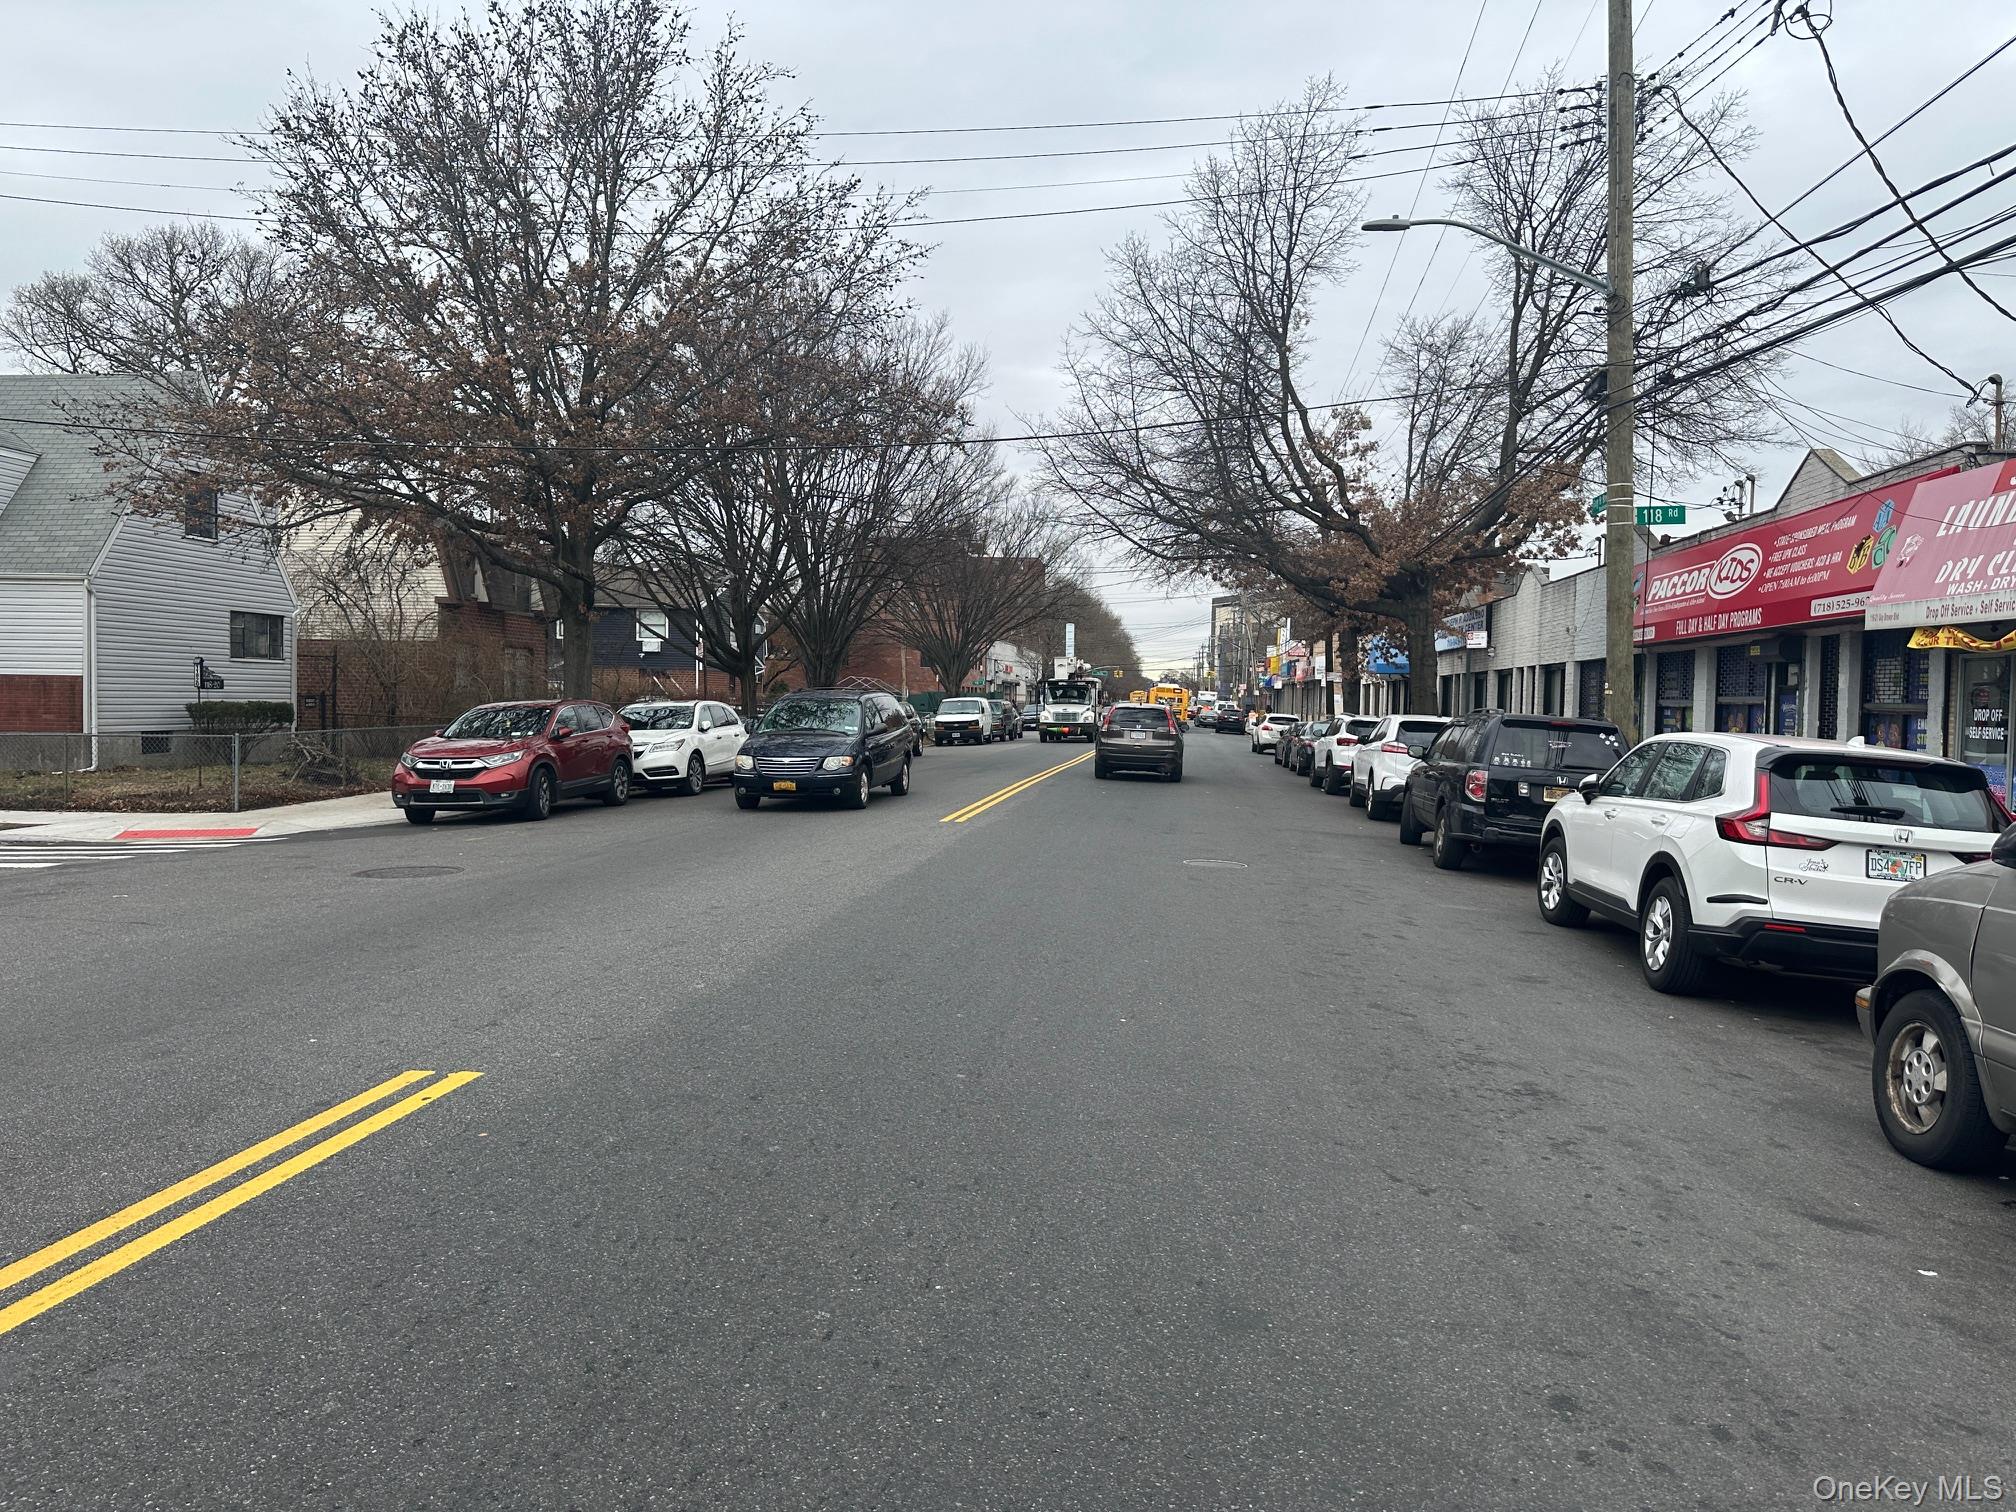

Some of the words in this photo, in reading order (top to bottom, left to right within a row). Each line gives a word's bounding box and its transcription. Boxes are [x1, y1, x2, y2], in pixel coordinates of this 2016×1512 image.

[1642, 509, 1662, 522] 118
[1668, 508, 1678, 517] Rd
[1935, 554, 1984, 584] DRY
[1647, 567, 1711, 602] PACCOR
[1714, 557, 1755, 587] KIDS
[1946, 580, 1984, 596] WASH
[1990, 577, 2016, 591] DRY
[1814, 601, 1834, 614] (718)
[1926, 606, 1939, 621] Drop
[1940, 604, 1950, 618] Off
[1950, 602, 1974, 618] Service
[1980, 600, 1993, 614] Self
[1676, 620, 1688, 636] FULL
[1687, 618, 1698, 634] DAY
[1698, 616, 1703, 632] &
[1704, 614, 1718, 632] HALF
[1718, 612, 1729, 630] DAY
[1729, 608, 1763, 629] PROGRAMS
[1974, 708, 1990, 722] DROP
[1990, 708, 2002, 722] OFF
[1982, 727, 2004, 740] SERVICE
[1870, 858, 1890, 872] DS4
[1903, 860, 1922, 874] 7FP
[1774, 876, 1808, 886] CR-V
